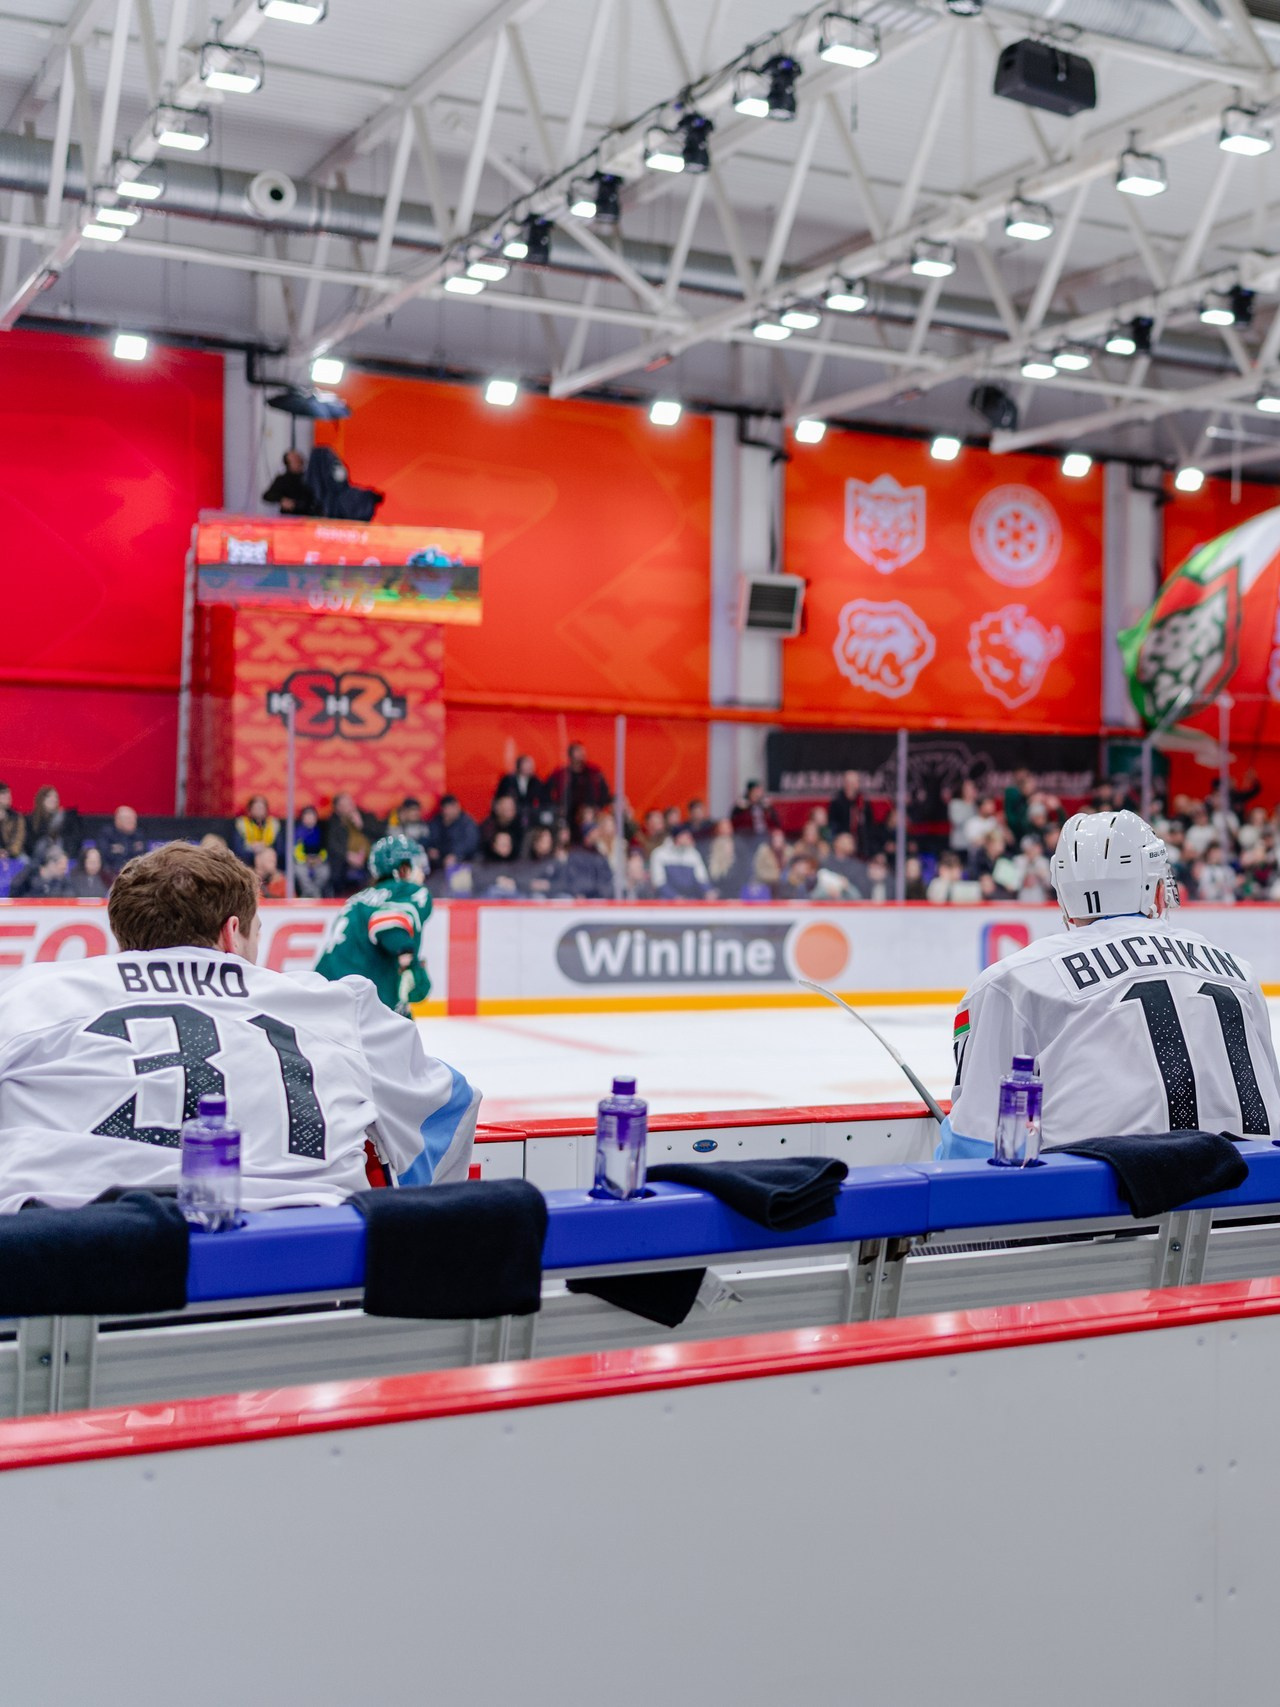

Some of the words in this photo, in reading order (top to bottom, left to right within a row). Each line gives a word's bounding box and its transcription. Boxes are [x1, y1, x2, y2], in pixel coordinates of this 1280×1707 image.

[1084, 891, 1101, 914] 11
[575, 929, 776, 977] Winline
[1062, 935, 1246, 990] BUCHKIN
[117, 961, 249, 998] BOIKO
[84, 1002, 327, 1161] 31
[1121, 979, 1270, 1134] 11
